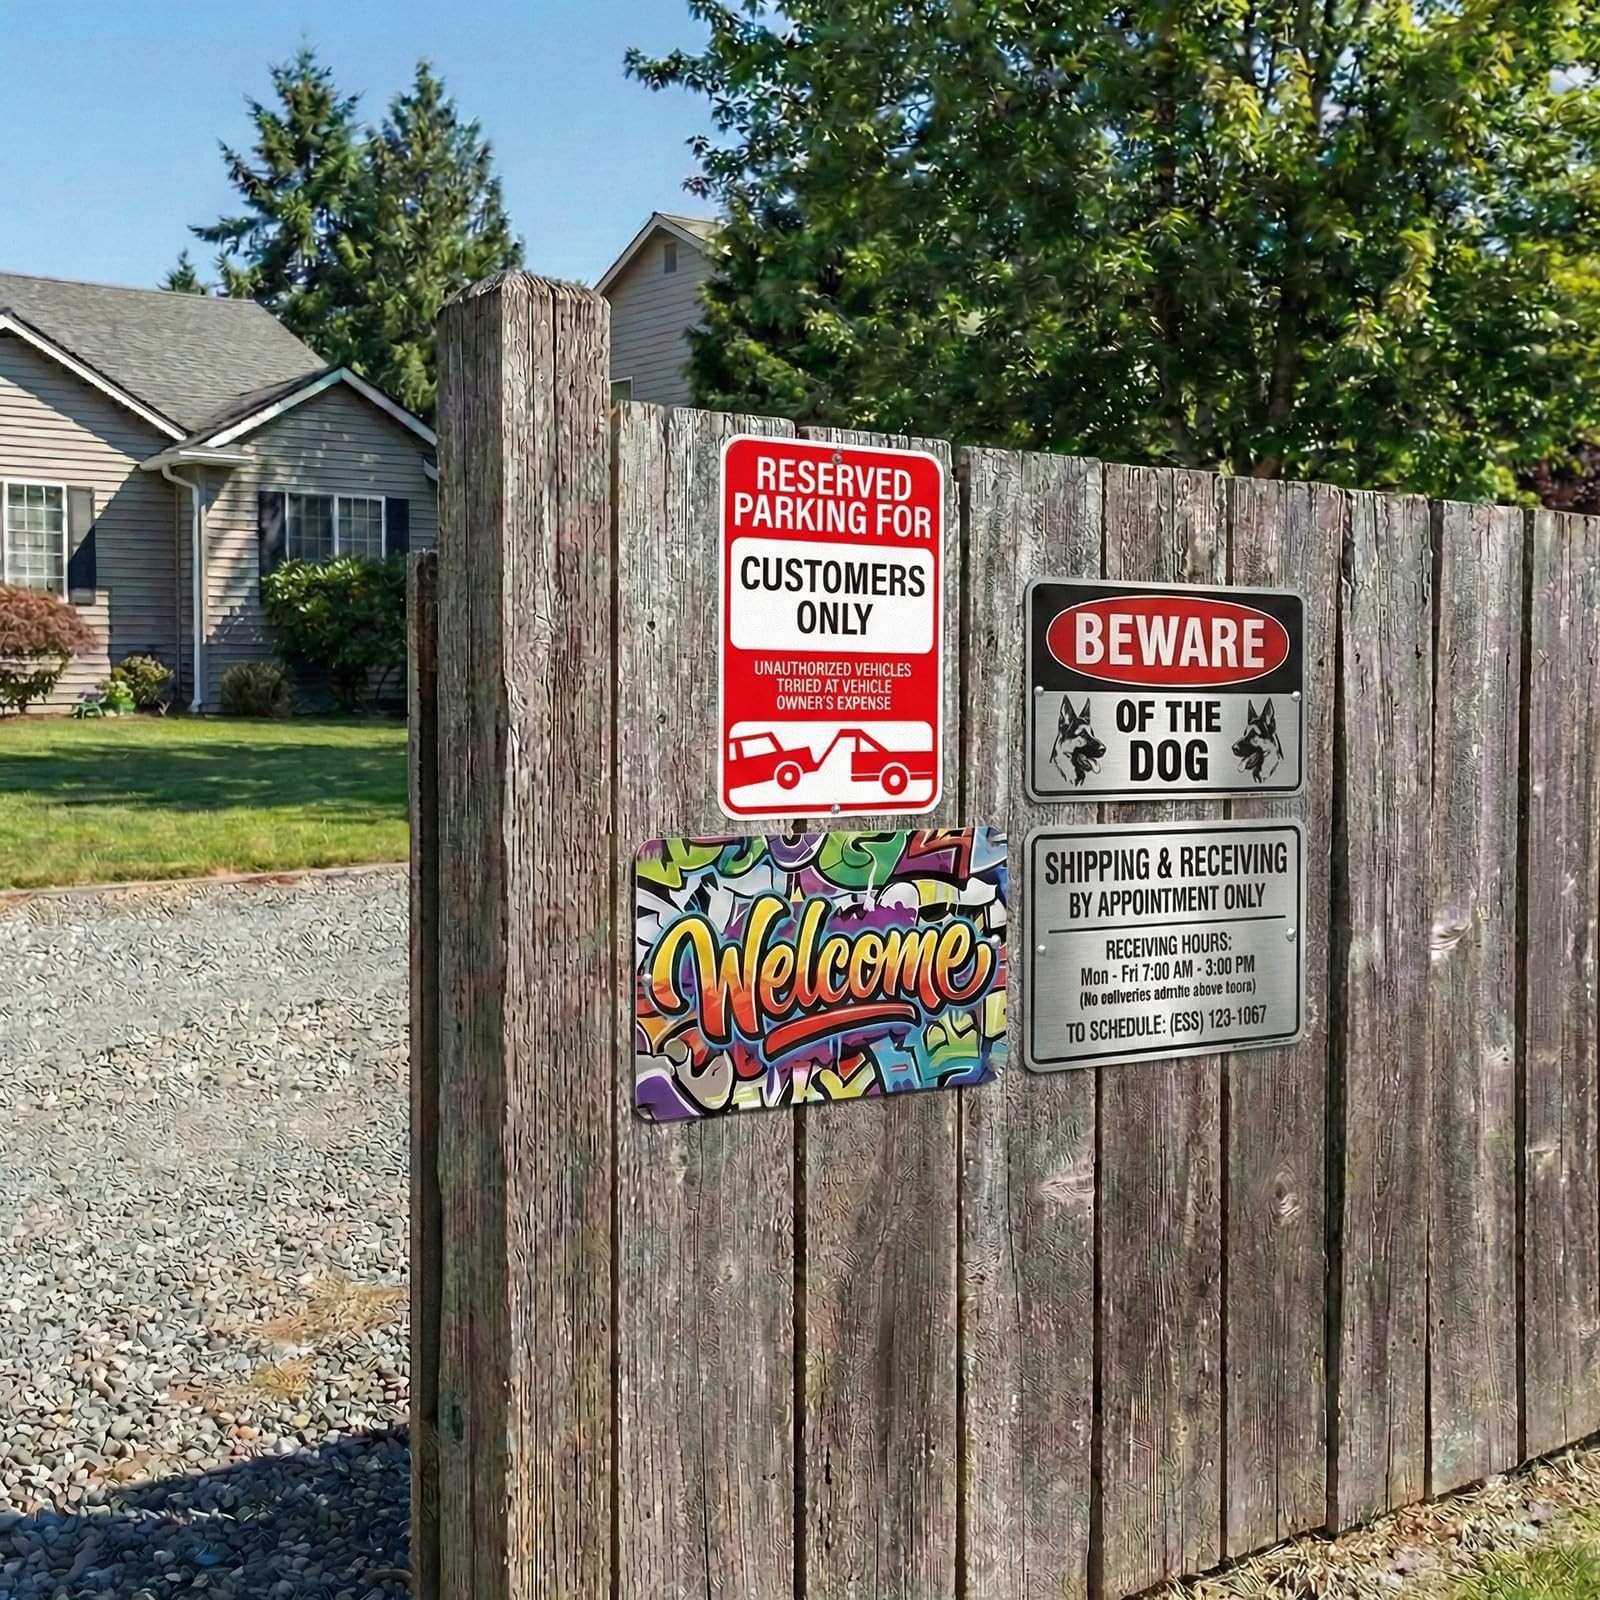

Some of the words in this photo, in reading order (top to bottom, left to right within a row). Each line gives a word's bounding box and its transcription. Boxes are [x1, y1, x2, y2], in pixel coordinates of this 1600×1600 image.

[757, 456, 912, 501] RESERVED
[734, 492, 867, 535] PARKING
[876, 503, 931, 539] FOR
[740, 556, 925, 597] CUSTOMERS
[797, 600, 874, 635] ONLY
[1075, 612, 1265, 668] BEWARE
[754, 660, 851, 677] UNAUTHORIZED
[855, 663, 912, 677] VEHICLES
[824, 678, 840, 693] AT
[842, 679, 892, 694] VEHICLE
[776, 695, 834, 710] OWNER'S
[837, 696, 891, 711] EXPENSE
[1116, 699, 1155, 733] OF
[1165, 700, 1221, 733] THE
[1130, 739, 1209, 782] DOG
[1045, 848, 1150, 885] SHIPPING
[1157, 847, 1172, 879] &
[1180, 842, 1288, 877] RECEIVING
[1069, 892, 1093, 919] BY
[1097, 885, 1219, 918] APPOINTMENT
[1224, 882, 1266, 909] ONLY
[1106, 935, 1178, 960] RECEIVING
[1181, 932, 1232, 954] HOURS:
[651, 896, 993, 1037] Welcome
[1080, 967, 1109, 986] Mon
[1121, 963, 1139, 983] Fri
[1142, 962, 1170, 981] 7:00
[1173, 959, 1193, 979] AM
[1205, 957, 1232, 976] 3:00
[1235, 955, 1255, 973] PM
[1080, 991, 1098, 1010] (No
[1193, 982, 1223, 997] above
[1066, 1023, 1086, 1043] TO
[1090, 1014, 1166, 1041] SCHEDULE:
[1170, 1010, 1204, 1038] (ESS)
[1208, 1005, 1267, 1029] 123-1067
